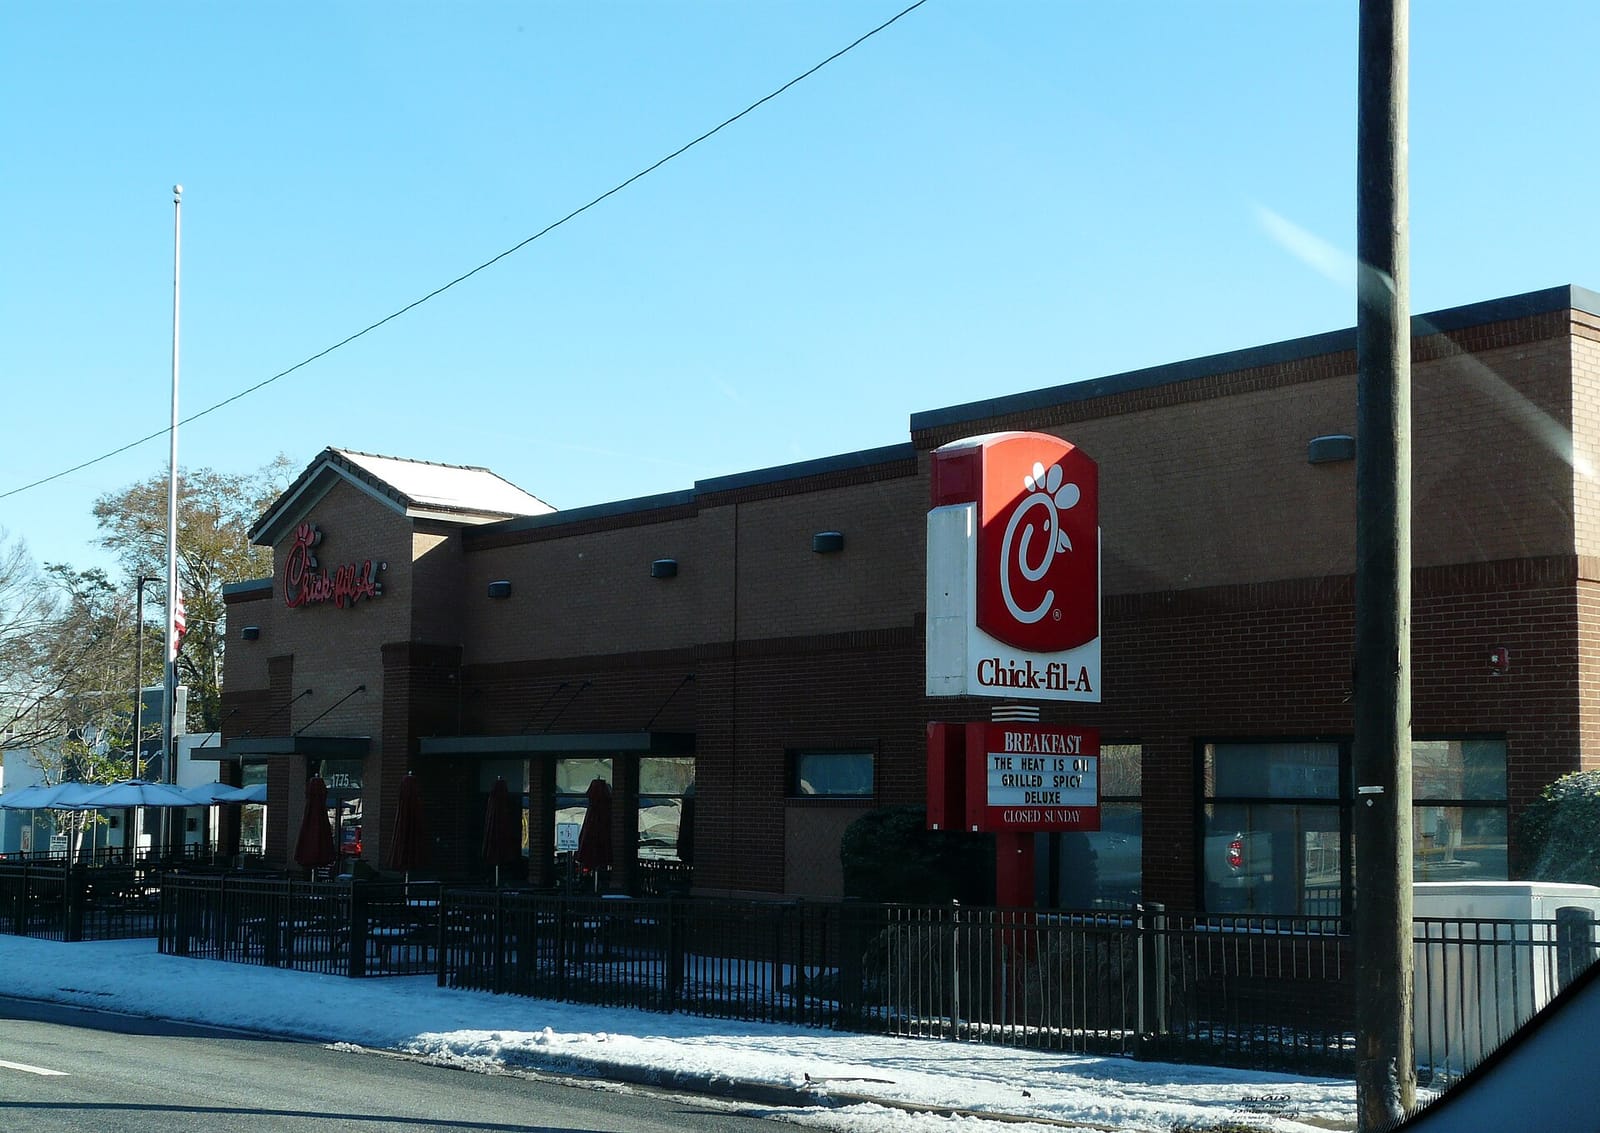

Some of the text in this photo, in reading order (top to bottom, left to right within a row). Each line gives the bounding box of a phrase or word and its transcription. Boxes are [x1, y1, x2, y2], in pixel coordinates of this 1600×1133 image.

[284, 538, 377, 608] Chick-fil-A
[977, 657, 1093, 692] Chick-fil-A
[1004, 731, 1082, 754] BREAKFAST
[994, 757, 1012, 770] THE
[1021, 758, 1045, 772] HEAT
[1053, 759, 1064, 772] IS
[1001, 774, 1082, 788] GRILLED SPICY
[1024, 791, 1061, 804] DELUXE
[1004, 810, 1081, 823] CLOSED SUNDAY
